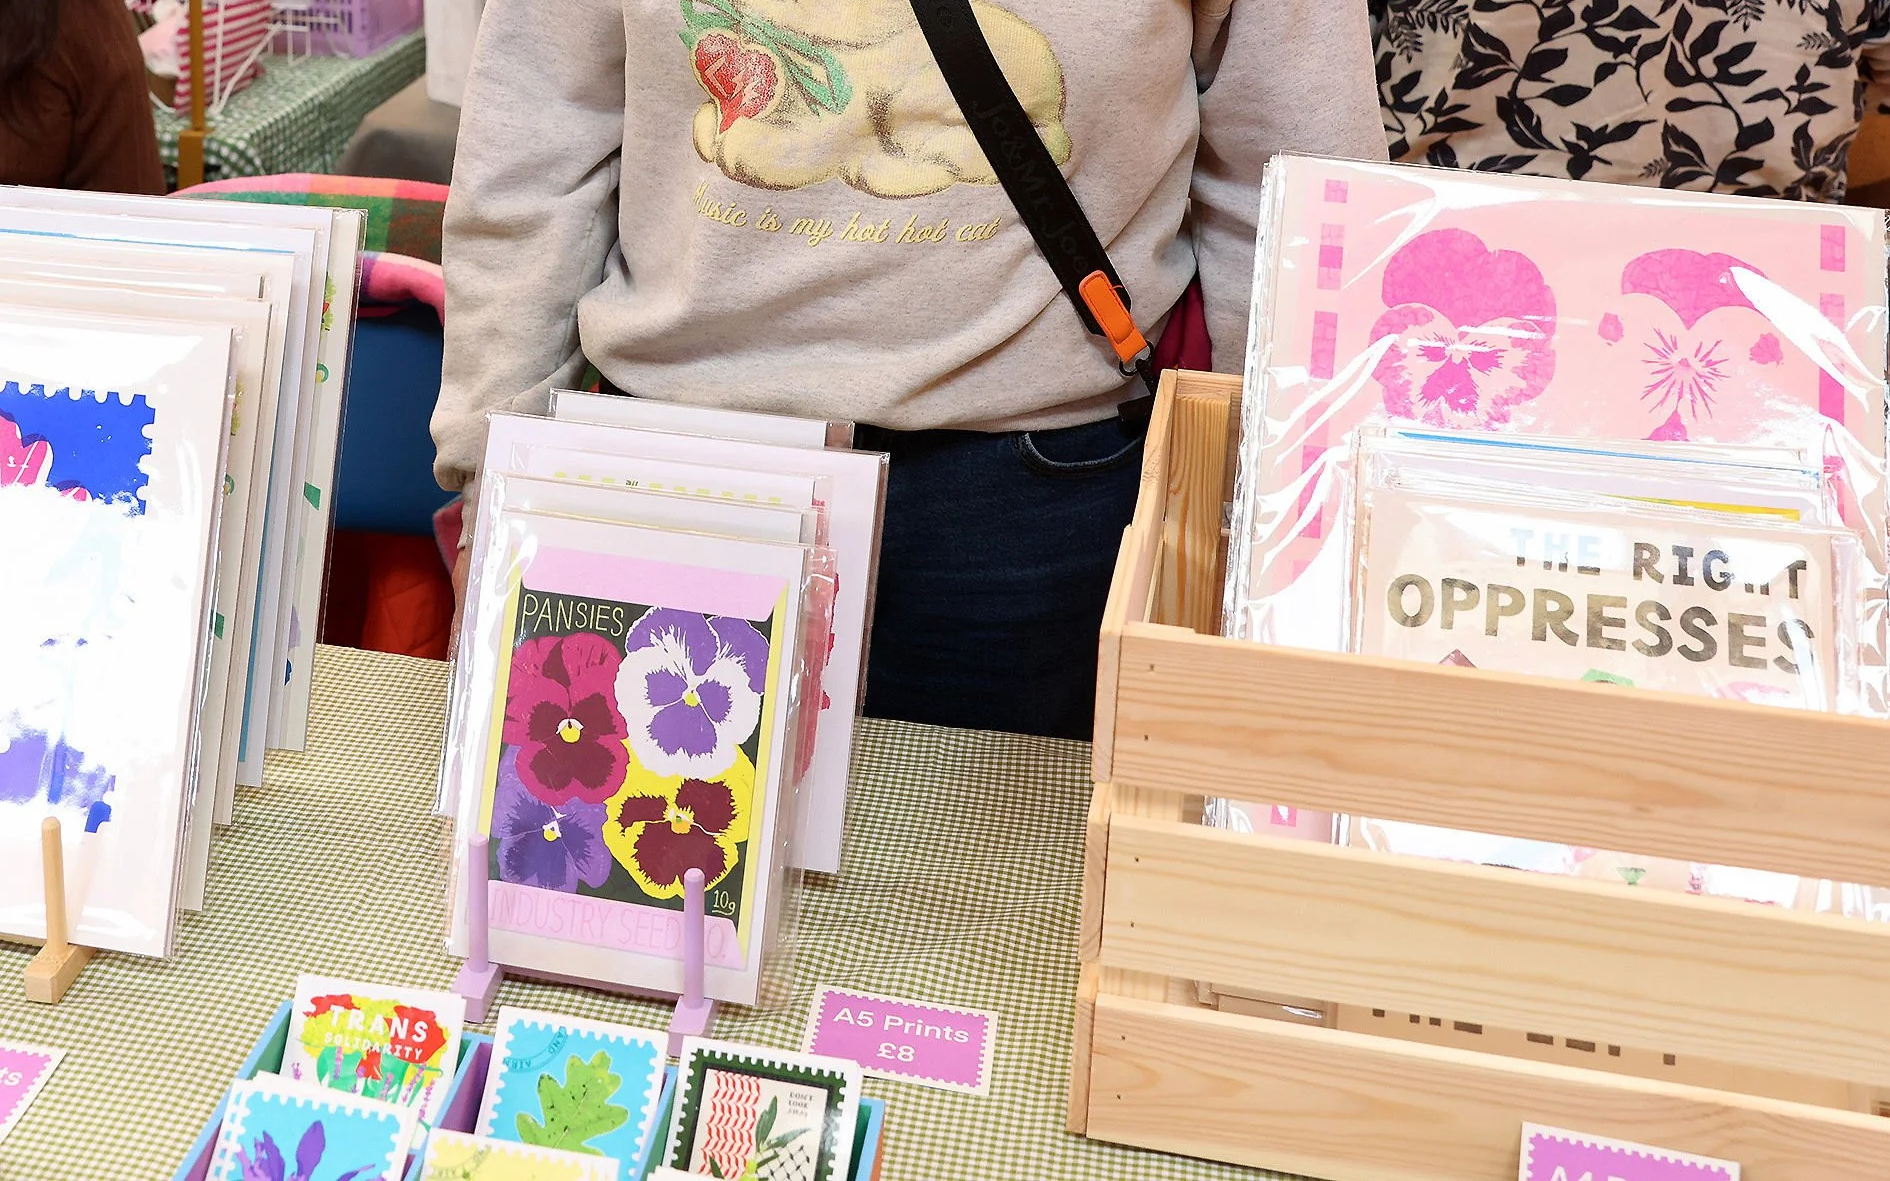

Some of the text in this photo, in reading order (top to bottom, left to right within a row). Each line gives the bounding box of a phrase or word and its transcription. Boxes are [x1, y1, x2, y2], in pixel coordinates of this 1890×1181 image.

[691, 180, 1002, 247] Music is my hot hot cat
[1509, 527, 1807, 601] THE RIGT
[520, 593, 624, 637] PANSIES
[1386, 573, 1815, 676] OPPRESSES
[490, 888, 613, 940] INDUSTRY
[713, 889, 736, 915] 10g
[329, 1004, 430, 1043] TRANS
[833, 1007, 970, 1043] A5 Prints
[324, 1032, 423, 1061] SOLIDARITY
[876, 1042, 916, 1063] £8
